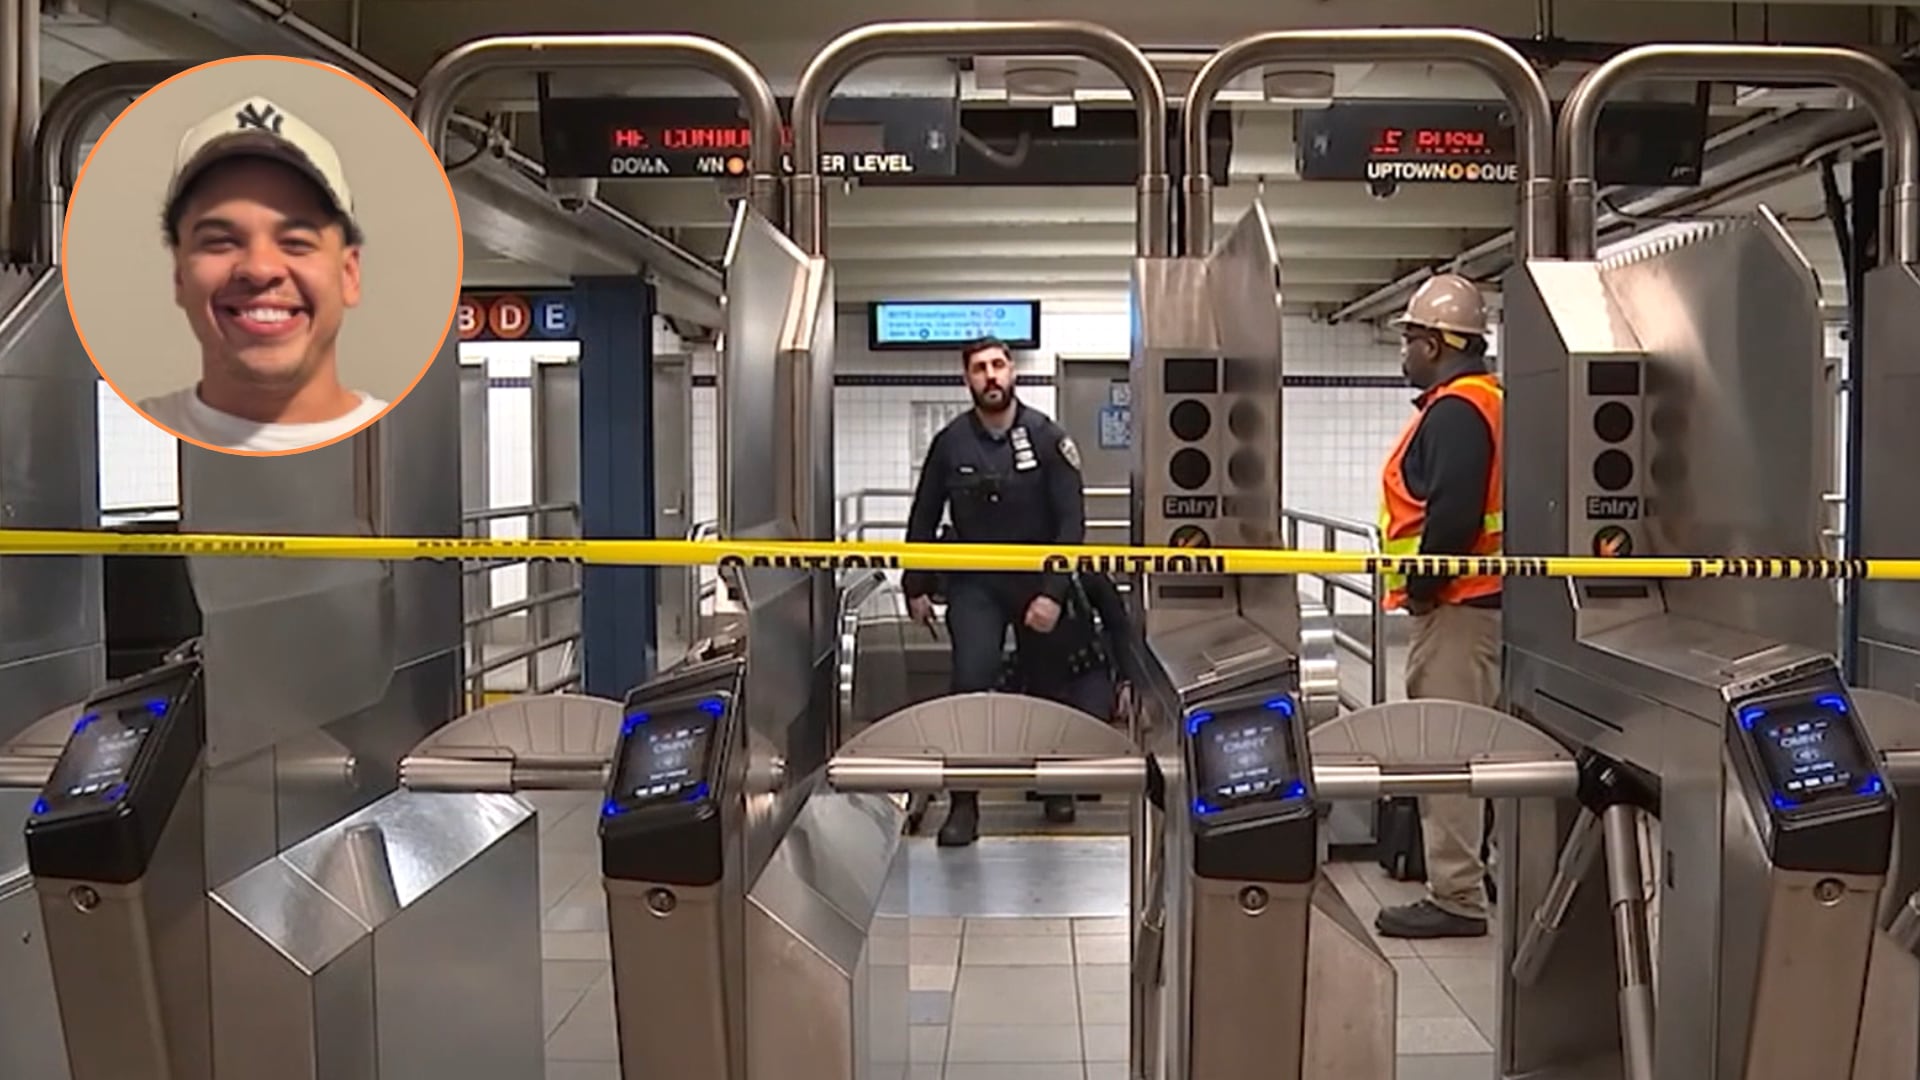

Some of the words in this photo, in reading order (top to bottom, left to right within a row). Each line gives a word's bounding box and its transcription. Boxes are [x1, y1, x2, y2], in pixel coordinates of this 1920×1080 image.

[854, 155, 914, 172] LEVEL
[1367, 162, 1448, 179] UPTOWN
[1481, 163, 1519, 181] QUE
[458, 304, 476, 331] B
[500, 304, 523, 330] D
[545, 304, 566, 330] E
[1166, 497, 1215, 518] Entry
[1589, 498, 1637, 518] Entry
